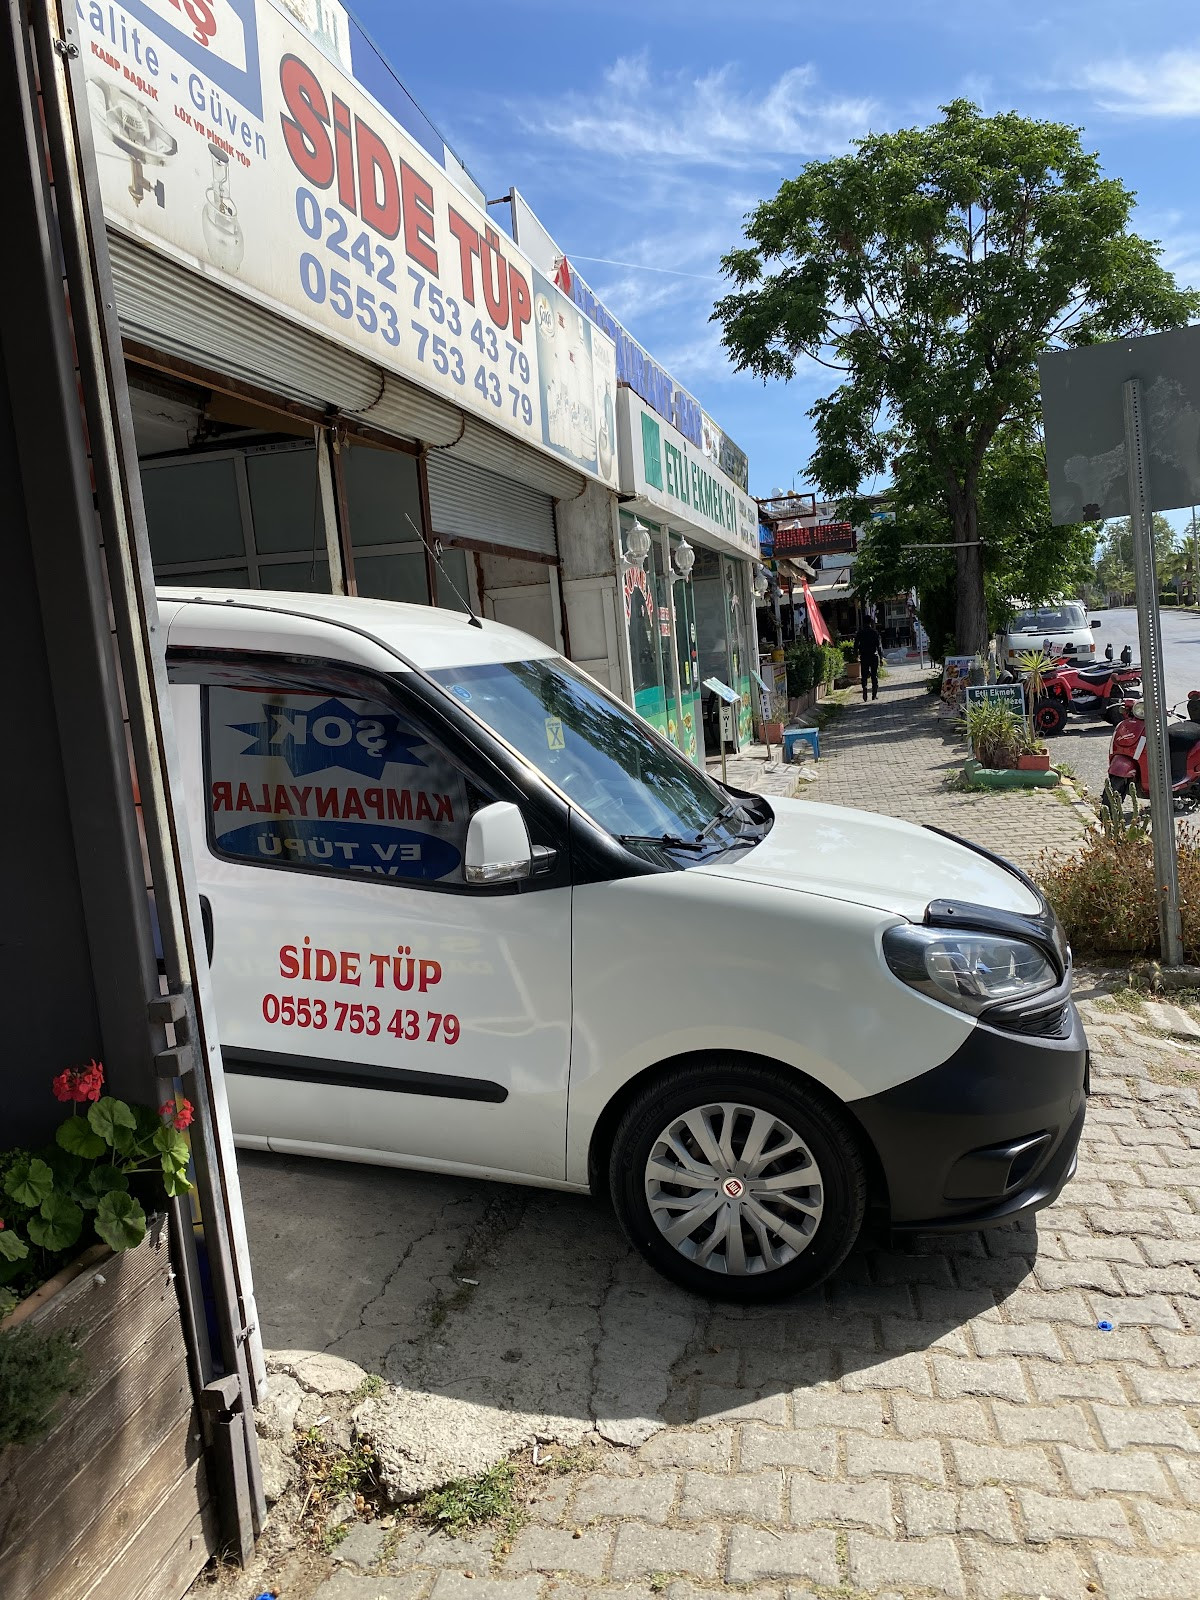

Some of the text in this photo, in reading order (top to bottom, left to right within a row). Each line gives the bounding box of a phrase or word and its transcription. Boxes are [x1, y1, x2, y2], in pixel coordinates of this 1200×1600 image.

[91, 40, 159, 102] KAMP BAŞLIK
[189, 73, 267, 160] Güven
[235, 149, 251, 168] TÜP
[279, 53, 532, 345] SİDE TÜP
[295, 187, 398, 293] 0242
[407, 266, 463, 337] 753
[471, 318, 500, 363] 43
[505, 340, 531, 386] 79
[300, 252, 533, 427] 0553 753 43 79
[664, 438, 690, 506] ETLİ
[691, 460, 726, 528] EKMEK
[725, 486, 738, 536] EVİ
[762, 694, 770, 720] EFES
[989, 687, 1016, 697] Ekmek
[280, 936, 442, 993] SİDE TÜP
[262, 993, 461, 1045] 0553 753 43 79
